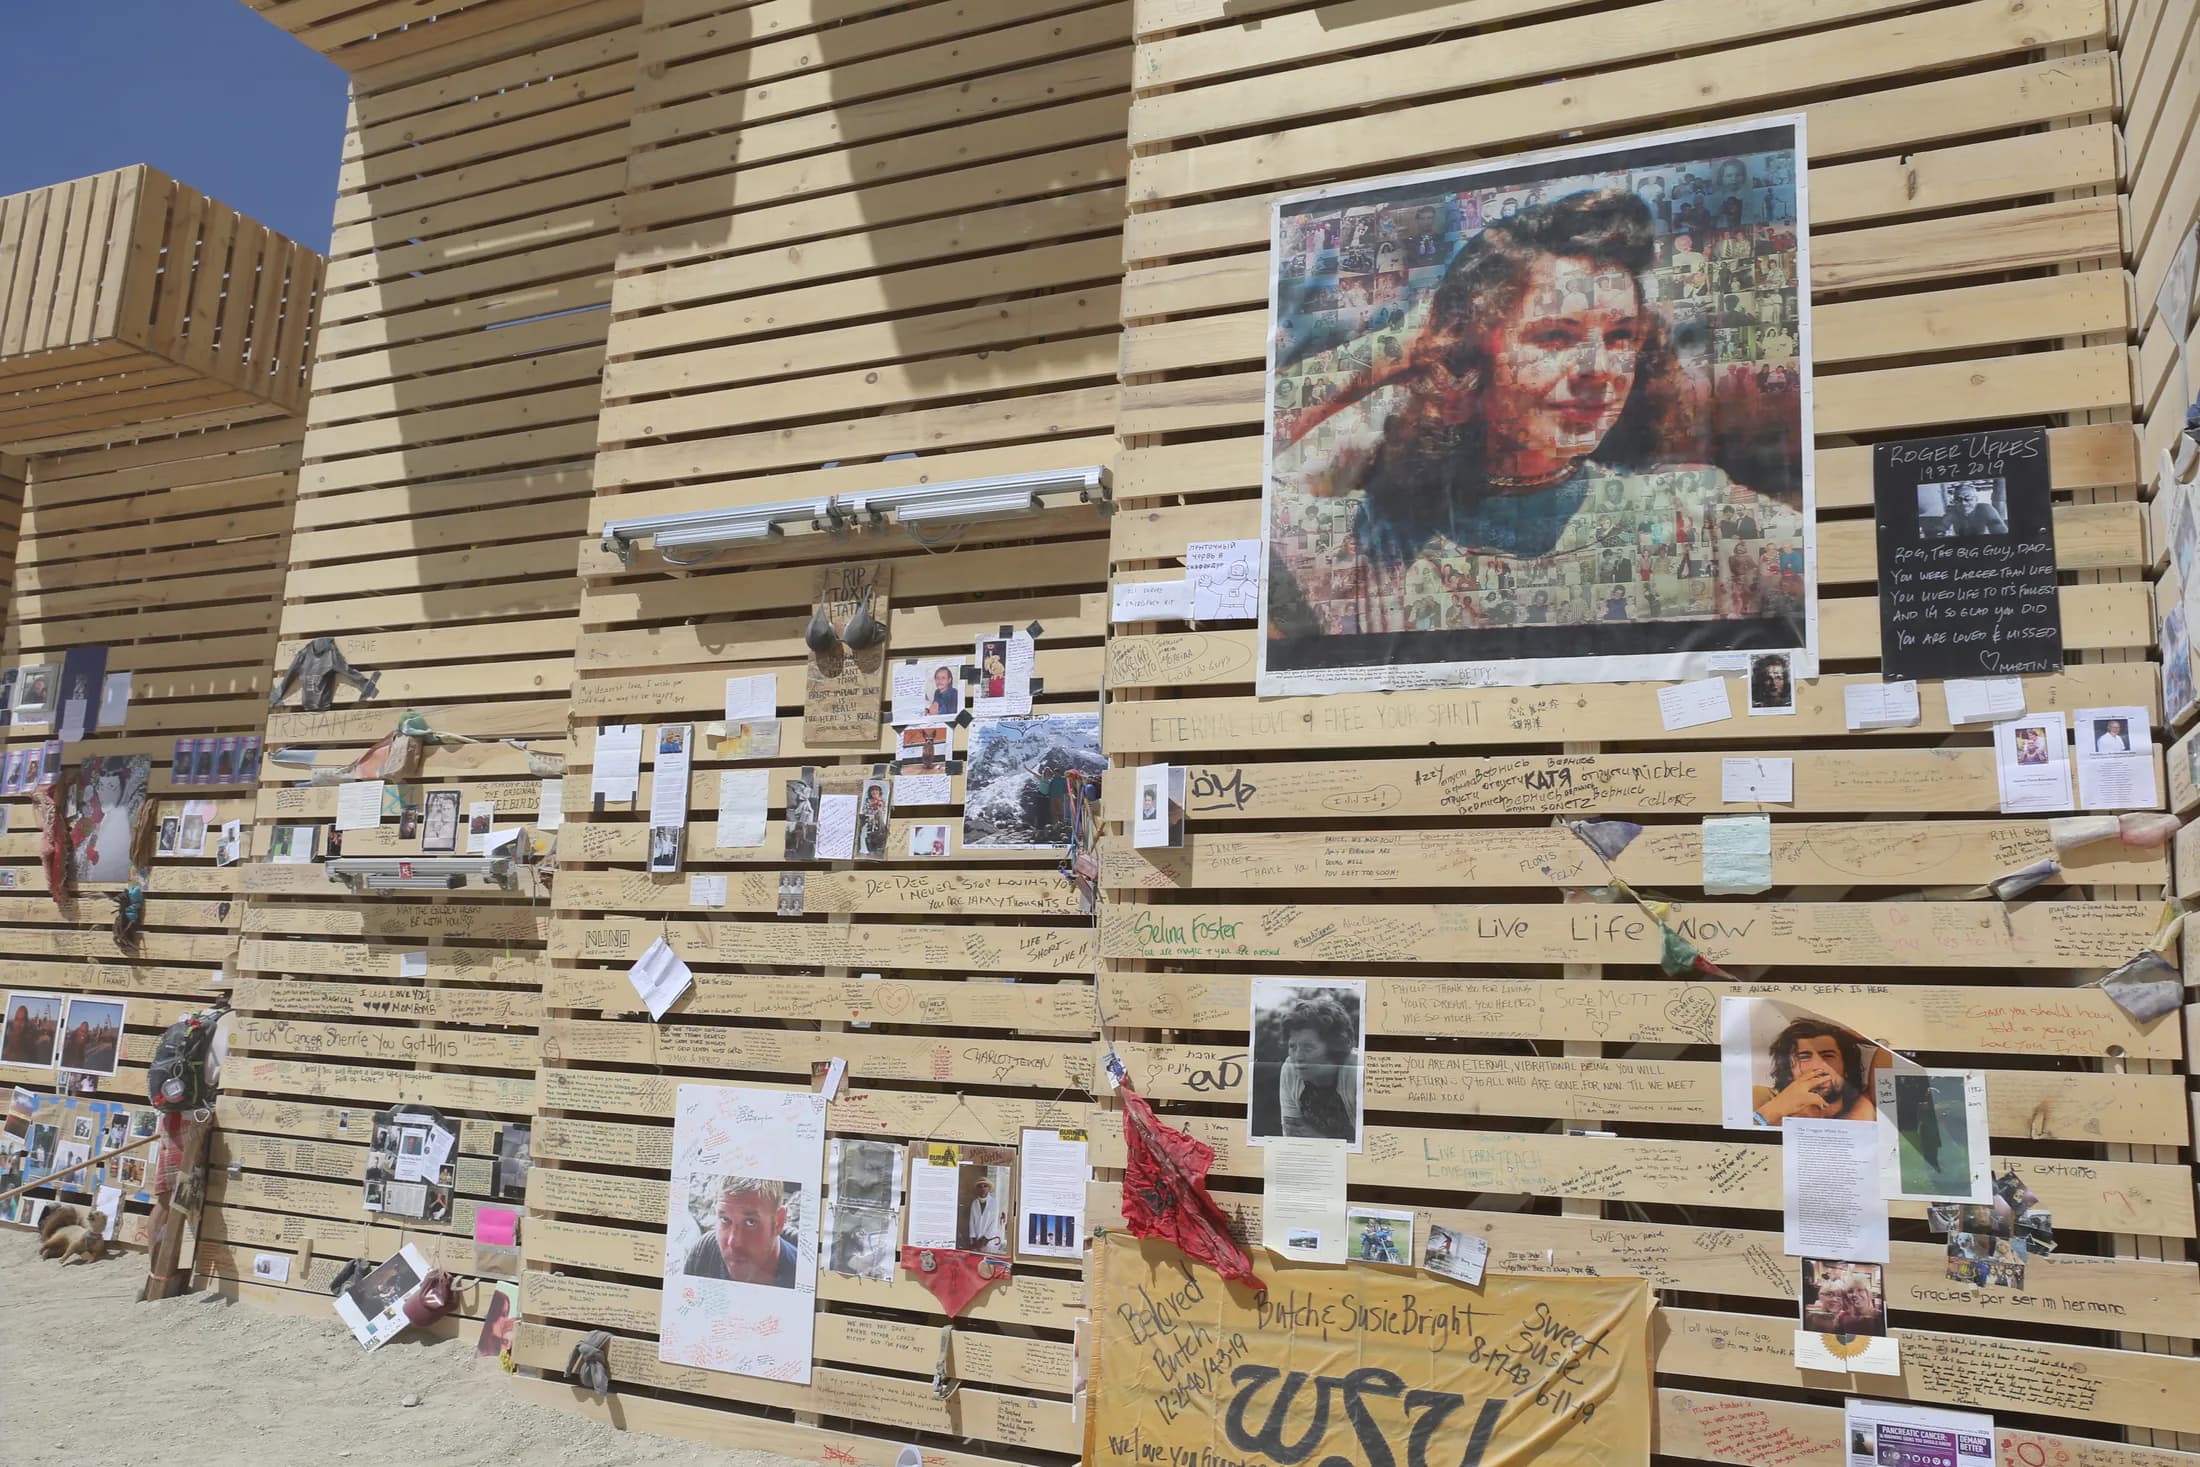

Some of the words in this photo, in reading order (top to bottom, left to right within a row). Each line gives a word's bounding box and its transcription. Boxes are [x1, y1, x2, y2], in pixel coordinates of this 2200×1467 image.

[1890, 444, 1961, 467] ROGER
[1931, 545, 1953, 560] THE
[843, 568, 866, 586] RIP
[1919, 571, 1949, 580] WERE
[1954, 568, 1999, 581] LARGER
[2000, 566, 2026, 576] THAN
[2029, 565, 2053, 574] LIFE
[1922, 591, 1954, 600] LIVED
[1957, 588, 1980, 600] LIFE
[1893, 611, 1918, 622] AND
[2021, 604, 2047, 614] DID
[1922, 633, 1947, 644] ARE
[1953, 631, 1987, 643] LOVED
[2007, 628, 2057, 639] MISSED
[2000, 659, 2048, 672] MARTIN
[1525, 768, 1572, 790] КАТЯ
[1133, 911, 1186, 946] Selina
[1192, 913, 1244, 943] Foster
[585, 930, 630, 948] NUNO
[1813, 985, 1844, 994] SEEK
[373, 1032, 395, 1050] You
[1402, 1056, 1425, 1072] YOU
[1637, 1064, 1665, 1075] WILL
[1409, 1076, 1448, 1088] RETURN
[1486, 1077, 1506, 1088] ALL
[1507, 1076, 1526, 1087] WHO
[1530, 1077, 1551, 1090] ARE
[1648, 1081, 1666, 1090] WE
[1667, 1079, 1696, 1090] MEET
[1910, 1284, 1971, 1302] Gracias
[1255, 1290, 1319, 1330] Butch
[1340, 1294, 1400, 1334] Susie
[1882, 1426, 1919, 1437] PANCREATIC
[1960, 1436, 1986, 1445] DEMAND
[1960, 1443, 1983, 1453] BETTER
